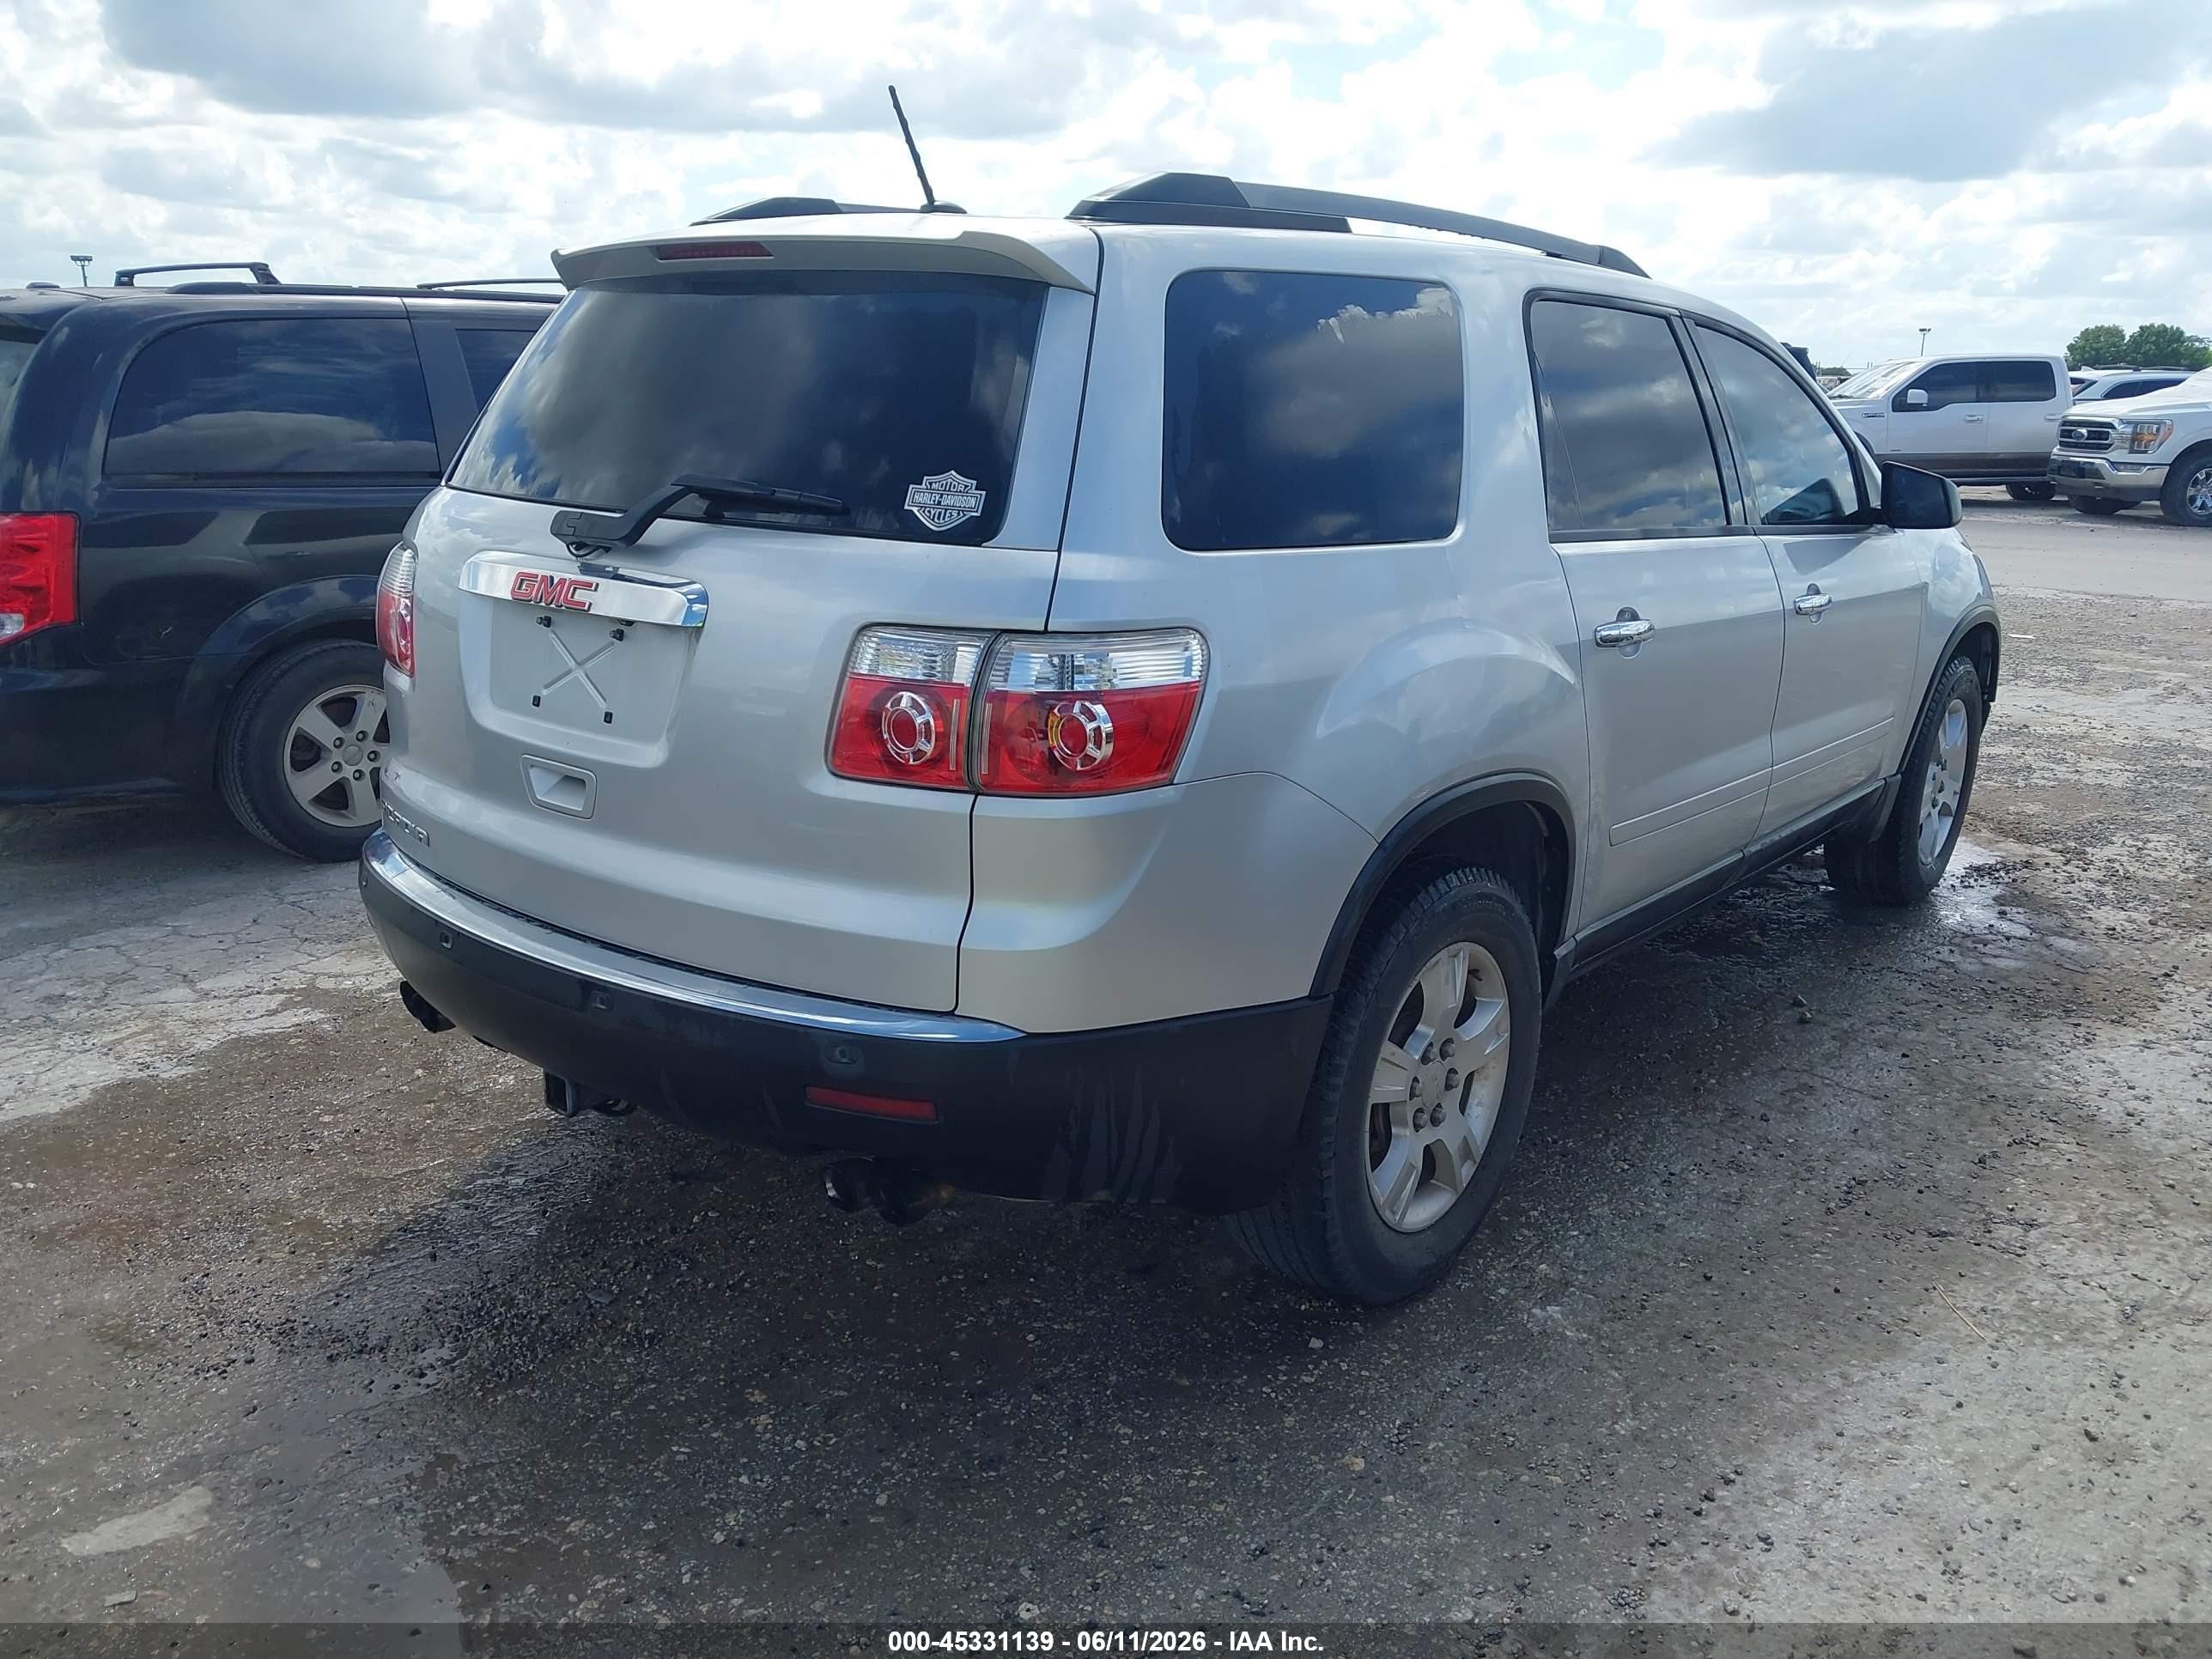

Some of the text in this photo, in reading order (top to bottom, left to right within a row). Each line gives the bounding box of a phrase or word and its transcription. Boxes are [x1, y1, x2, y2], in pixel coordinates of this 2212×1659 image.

[931, 479, 966, 493] MOTOR
[913, 491, 977, 508] HARLEY-DAVIDSON
[924, 507, 959, 524] CYCLES
[510, 571, 599, 612] GMC
